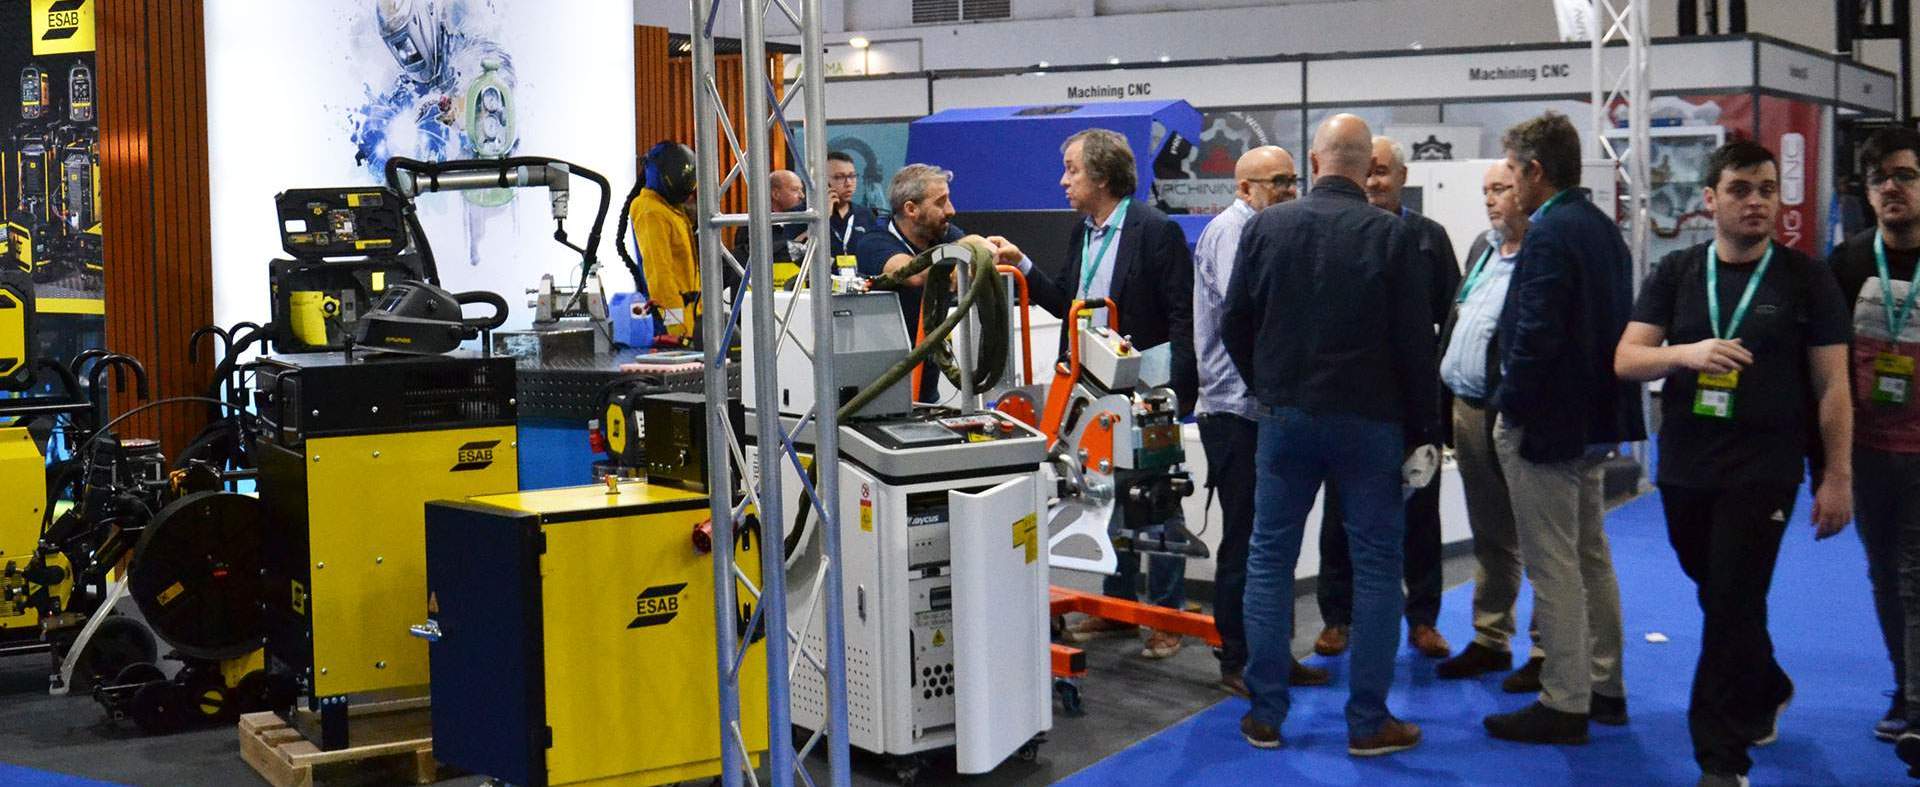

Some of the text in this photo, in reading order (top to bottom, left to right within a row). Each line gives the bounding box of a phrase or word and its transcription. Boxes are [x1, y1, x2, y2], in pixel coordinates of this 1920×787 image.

[48, 12, 79, 27] ESAB
[1469, 64, 1569, 81] Machining CNC
[1067, 82, 1151, 99] Machining CNC
[458, 449, 493, 462] ESAB
[636, 597, 679, 615] ESAB
